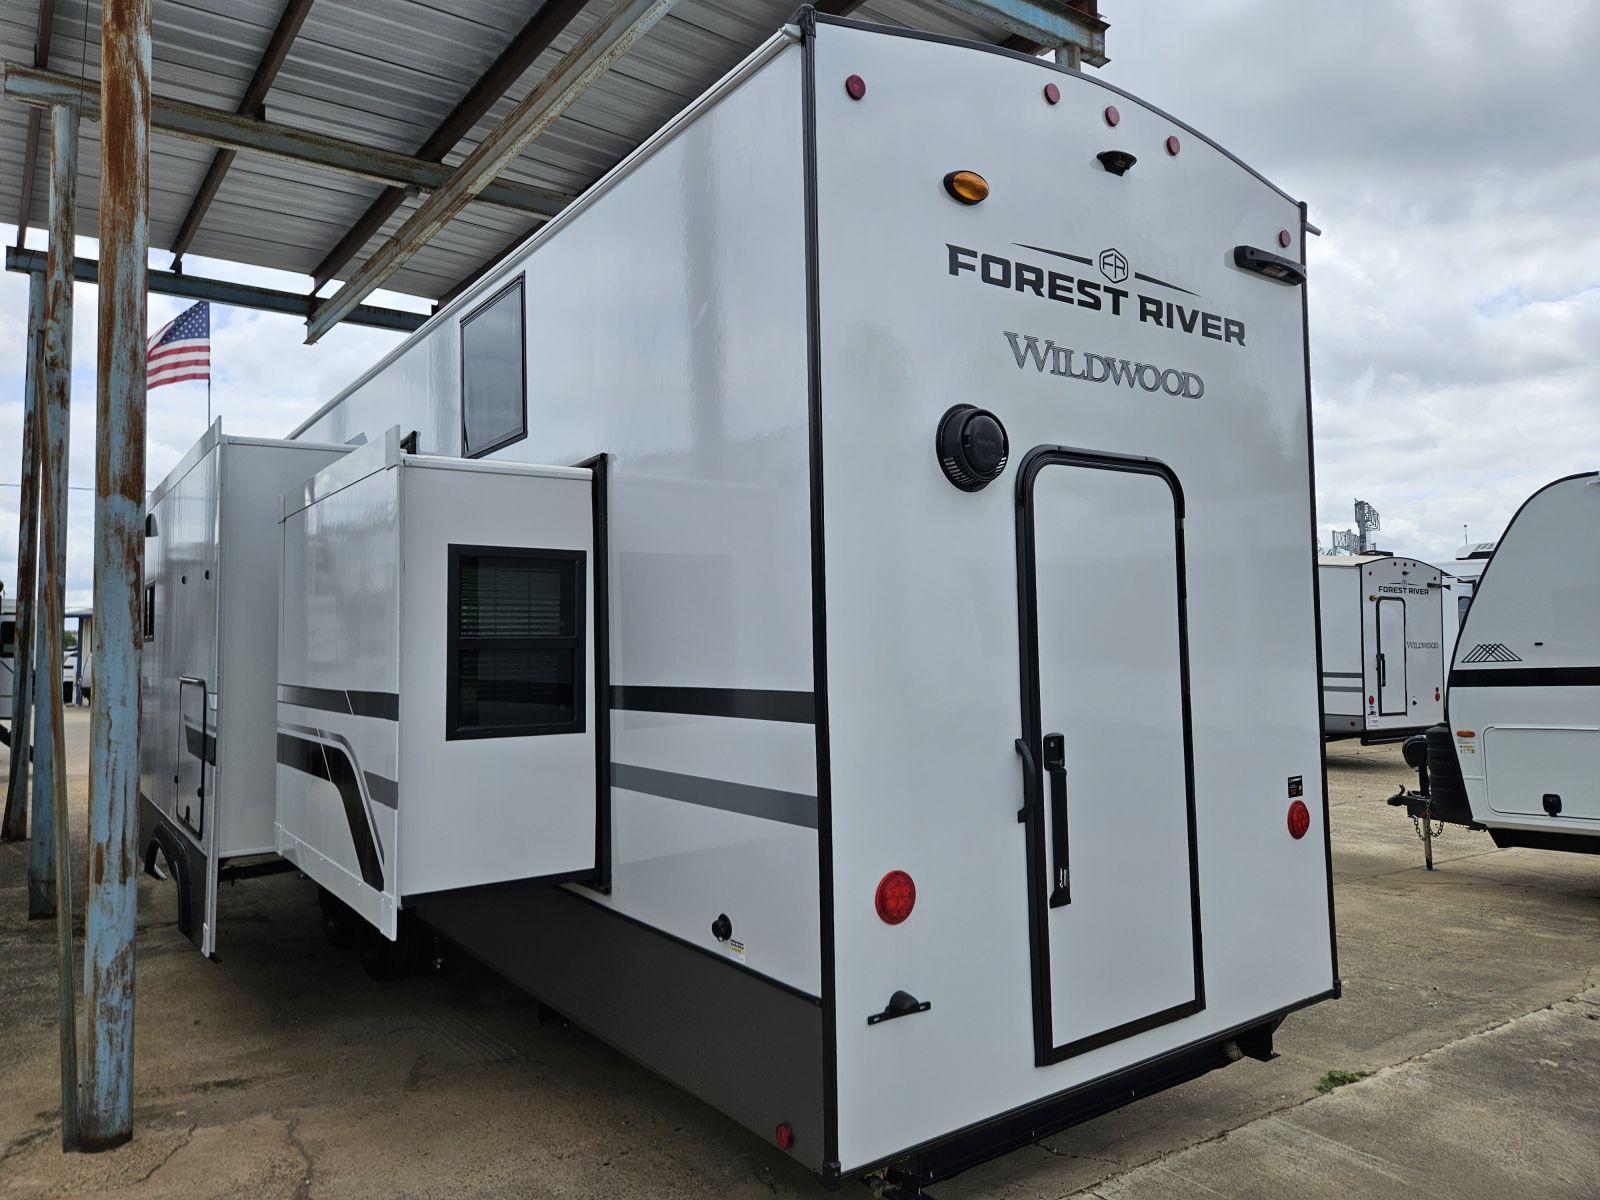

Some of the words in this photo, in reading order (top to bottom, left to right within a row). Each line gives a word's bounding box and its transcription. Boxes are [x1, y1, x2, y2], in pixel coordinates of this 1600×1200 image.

[945, 243, 1129, 316] FOREST
[1137, 294, 1246, 347] RIVER
[1003, 330, 1205, 400] WILDWOOD
[1378, 585, 1407, 594] FOREST
[1408, 587, 1429, 595] RIVER
